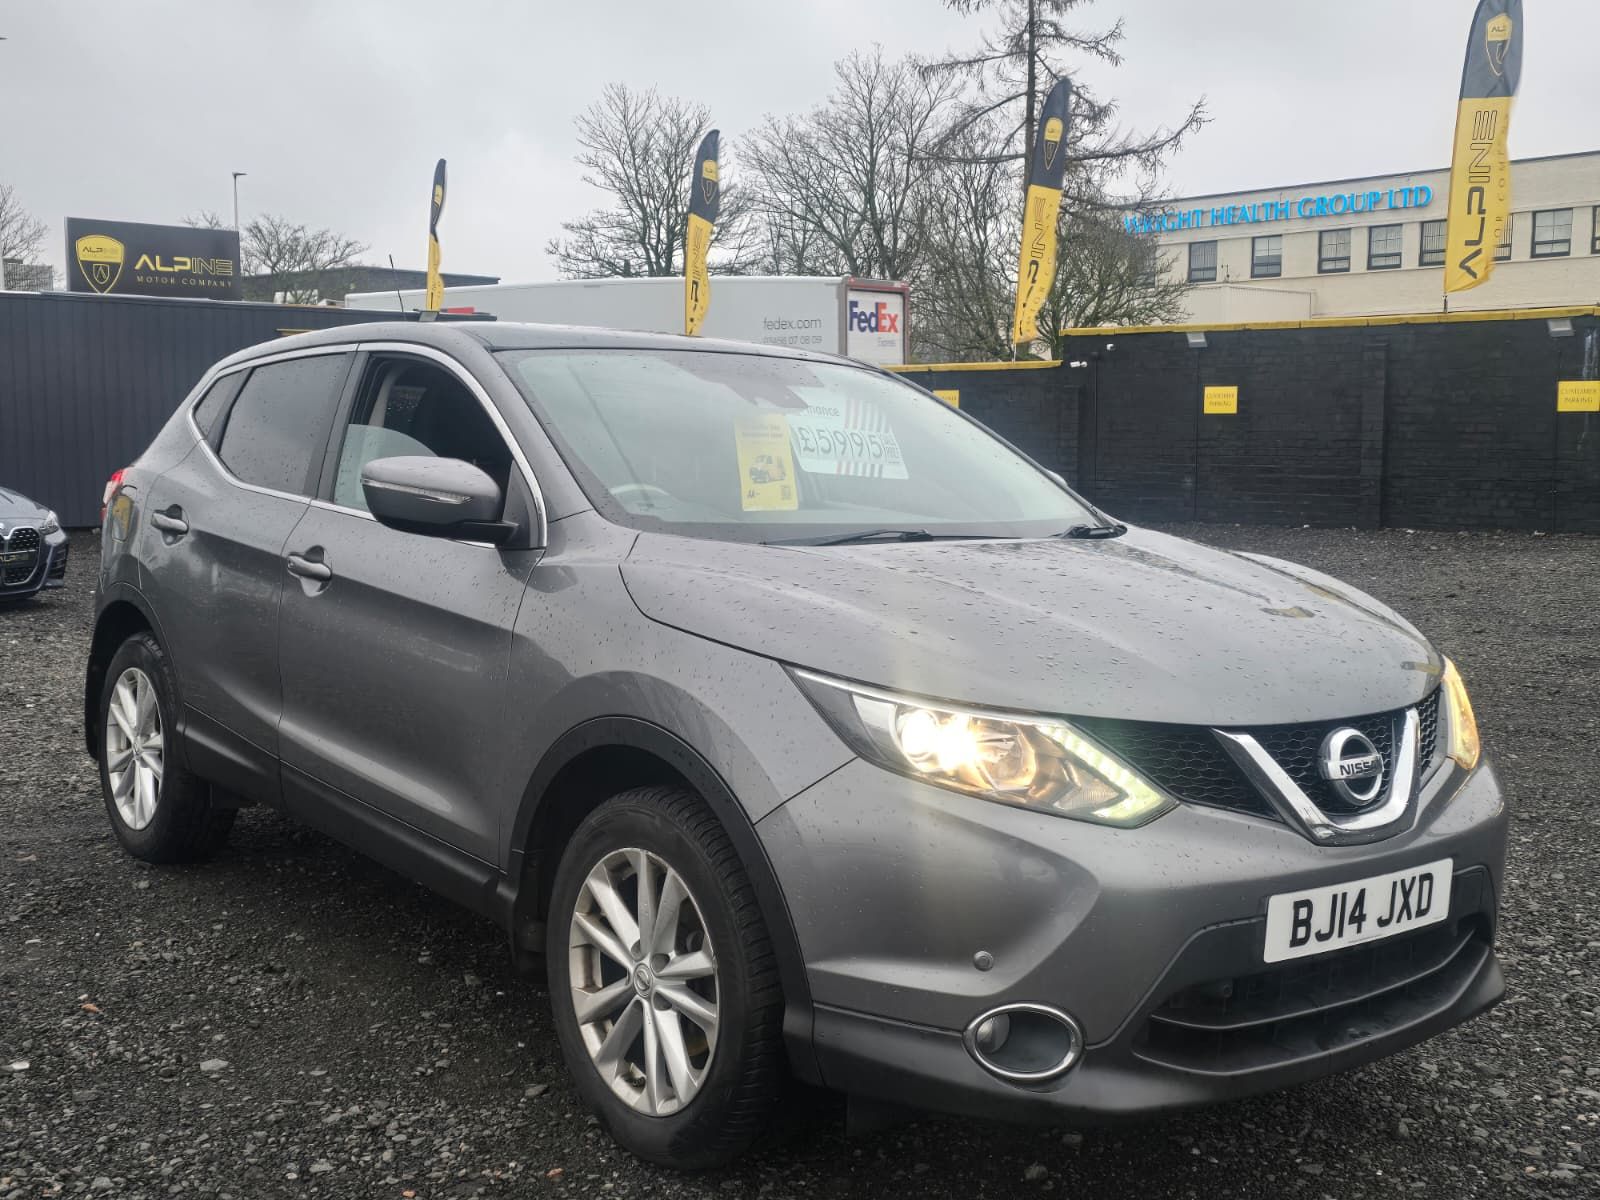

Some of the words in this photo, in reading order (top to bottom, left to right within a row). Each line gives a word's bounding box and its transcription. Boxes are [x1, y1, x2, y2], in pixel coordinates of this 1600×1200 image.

[1210, 200, 1291, 226] HEALTH
[1297, 191, 1382, 219] GROUP
[1388, 184, 1433, 209] LTD
[1458, 109, 1498, 280] ALPINE
[134, 254, 233, 276] ALPINE
[136, 276, 175, 285] MOTOR
[181, 278, 232, 288] COMPANY
[763, 316, 822, 330] fedex.com
[849, 300, 898, 333] FedEx
[1289, 887, 1367, 948] BJ14
[1376, 872, 1434, 928] JXD
